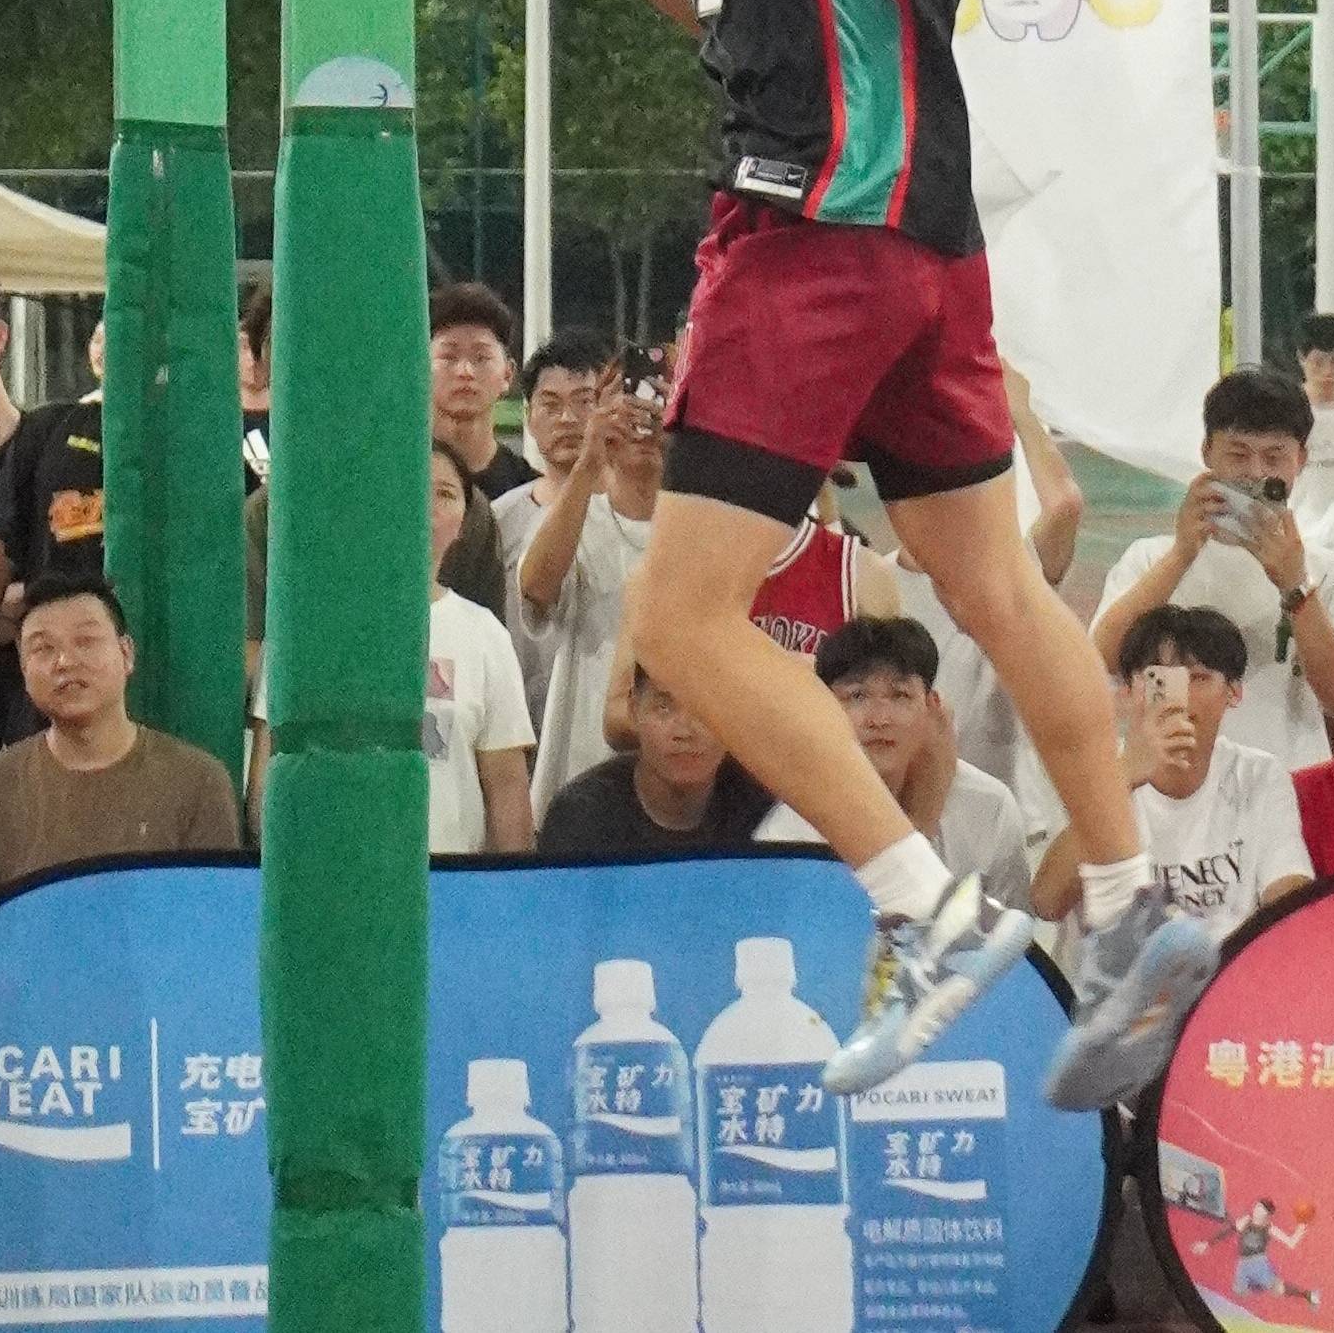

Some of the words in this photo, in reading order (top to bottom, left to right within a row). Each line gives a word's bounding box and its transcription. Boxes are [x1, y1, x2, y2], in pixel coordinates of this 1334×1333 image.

[716, 1082, 824, 1115] 宝矿力
[717, 1113, 786, 1144] 水特
